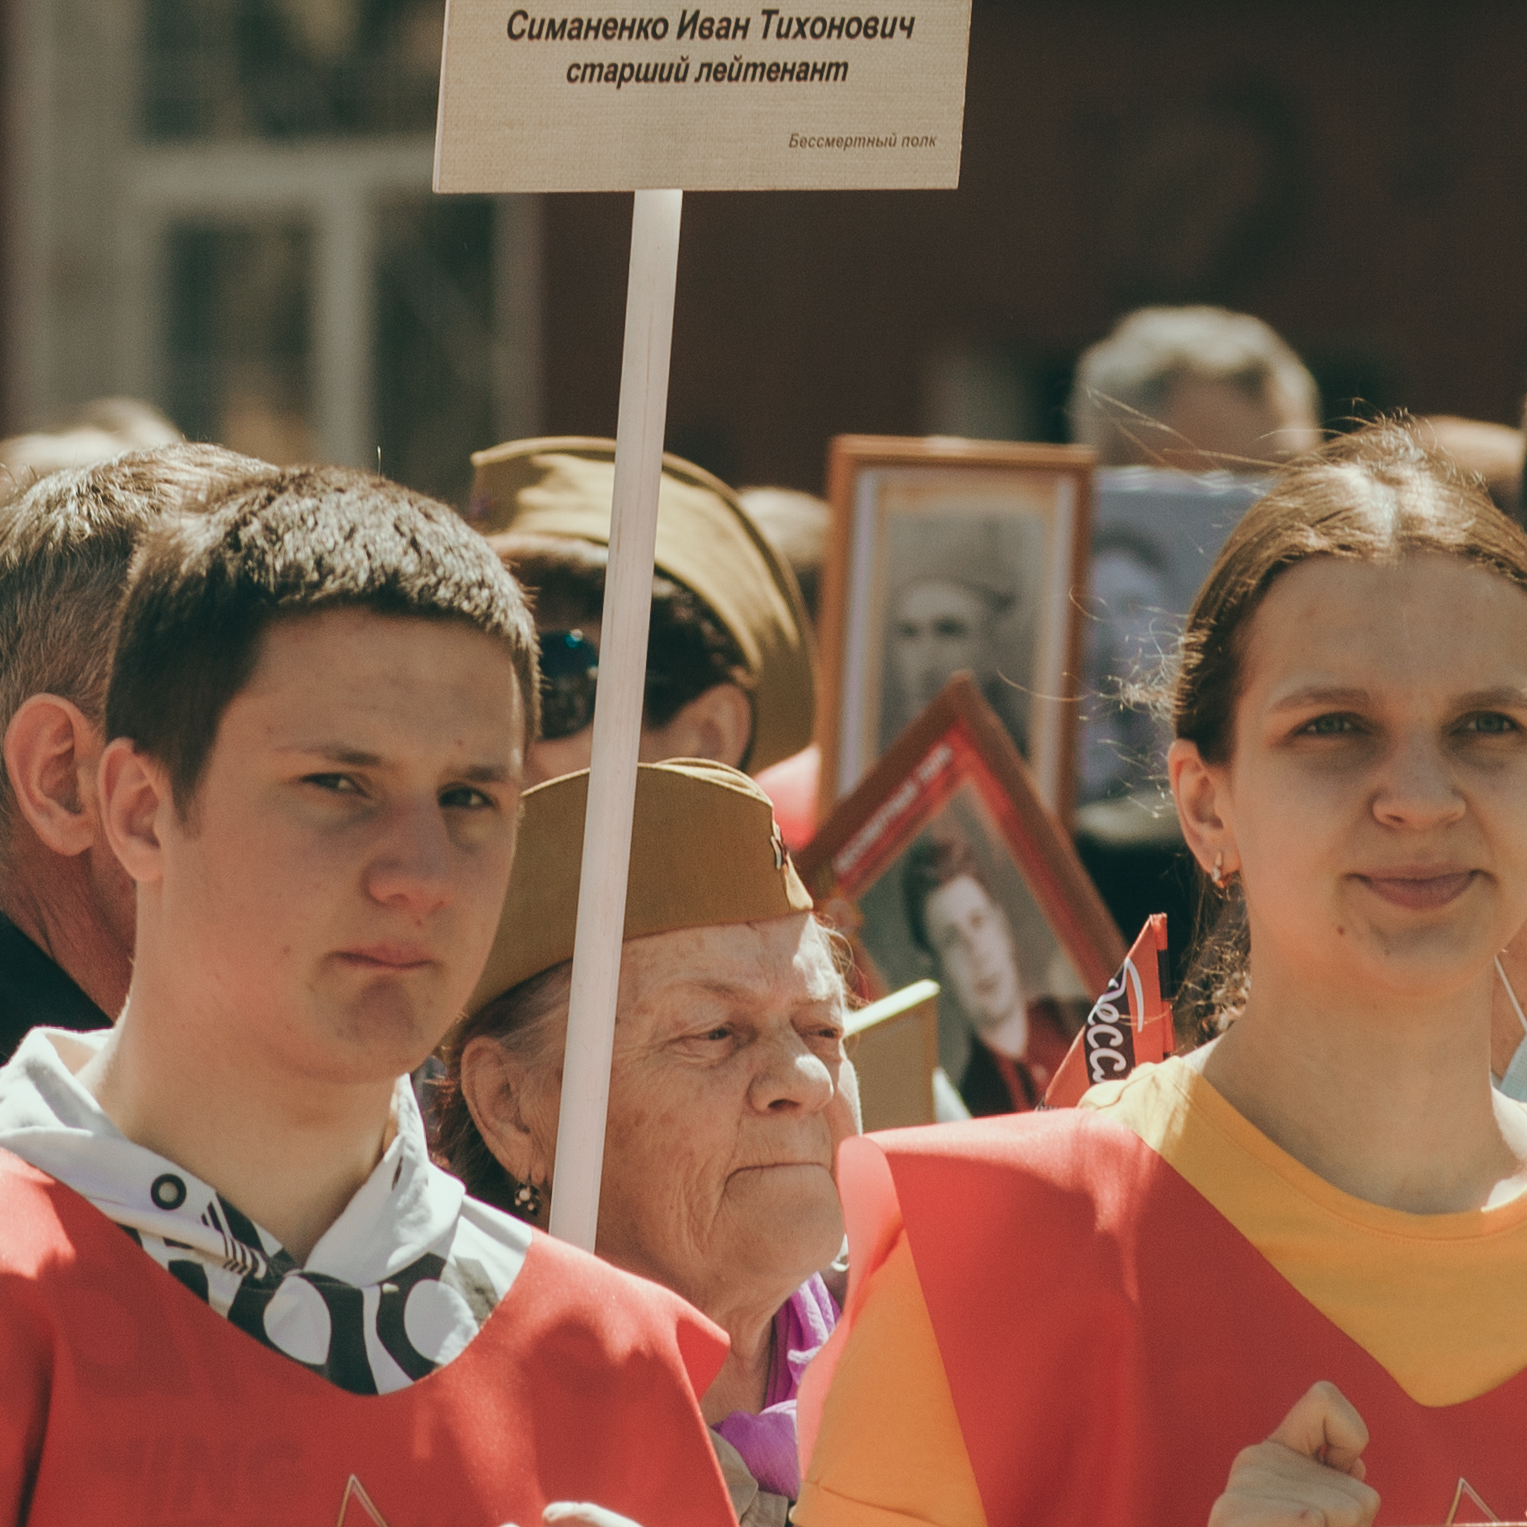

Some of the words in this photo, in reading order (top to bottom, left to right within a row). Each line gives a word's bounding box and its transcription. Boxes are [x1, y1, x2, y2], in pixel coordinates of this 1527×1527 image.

[506, 9, 669, 41] Симаненко
[676, 9, 750, 40] Иван
[760, 8, 916, 41] Тихонович
[566, 55, 691, 90] старший
[694, 55, 849, 84] лейтенант
[788, 132, 897, 151] Бессмертный
[901, 134, 938, 149] полк
